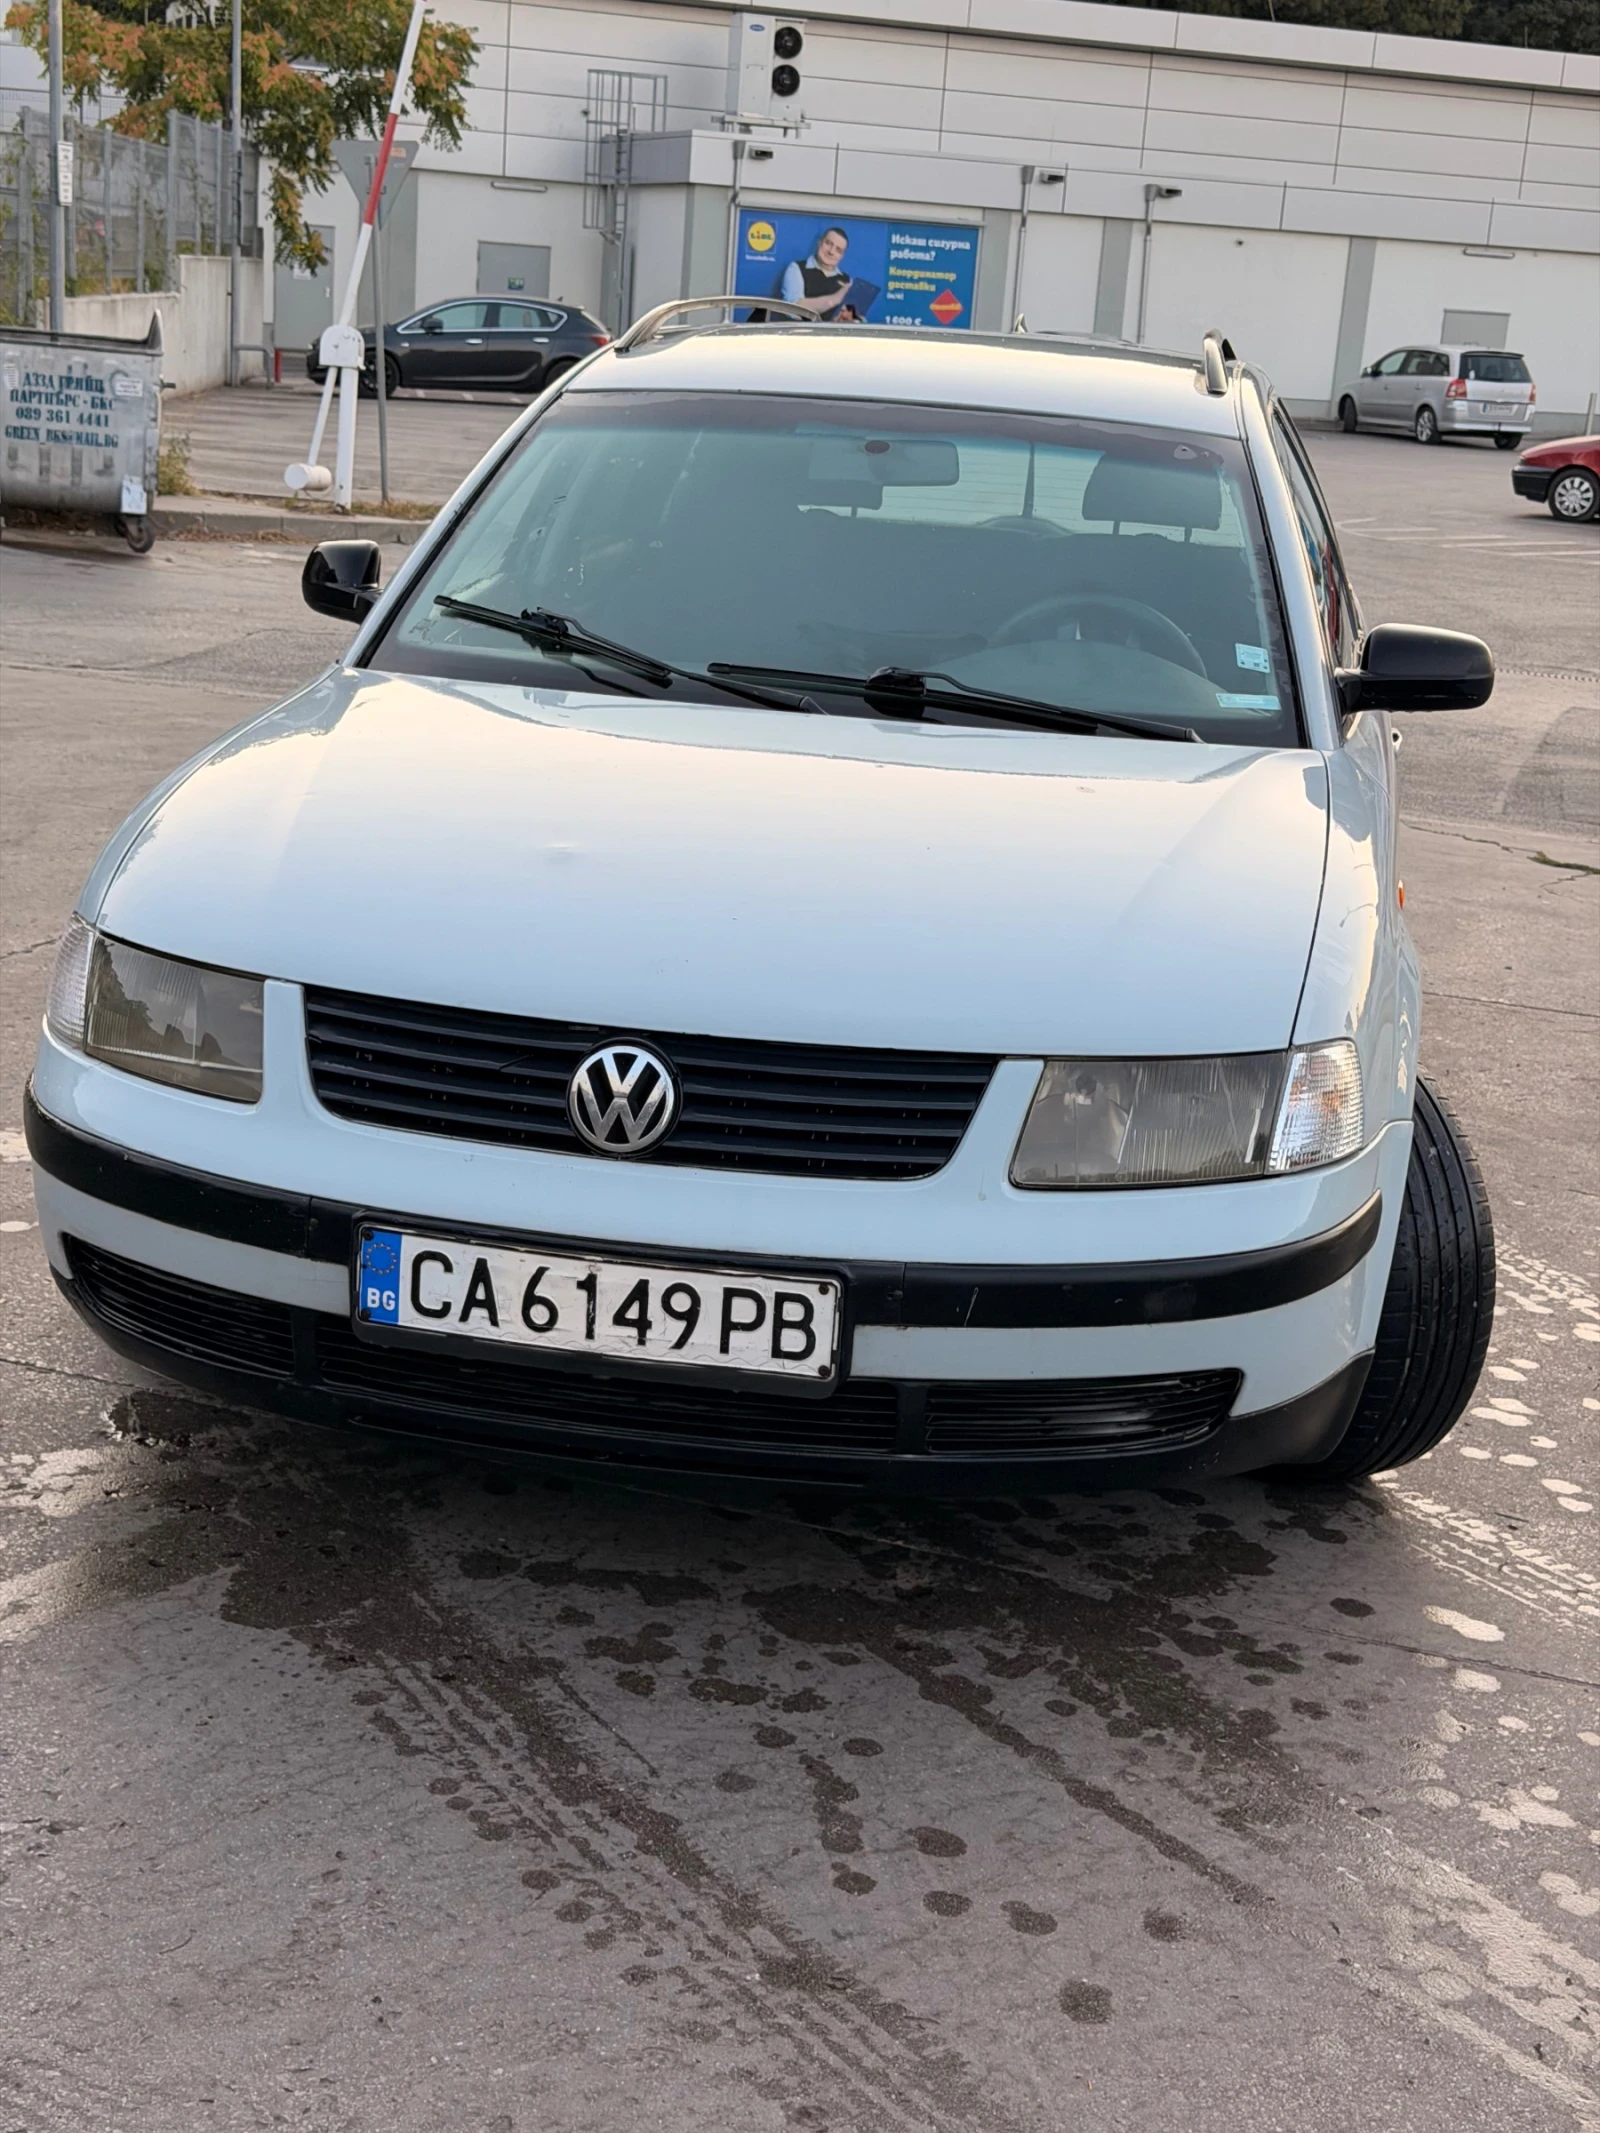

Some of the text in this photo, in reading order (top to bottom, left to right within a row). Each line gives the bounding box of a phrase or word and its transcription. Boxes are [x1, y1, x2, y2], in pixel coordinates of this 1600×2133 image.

[891, 234, 971, 251] Искаш сигурна
[890, 248, 936, 261] работа?
[22, 372, 55, 390] АЗЗА
[15, 407, 110, 428] 089 361 4441
[366, 1287, 396, 1312] BG
